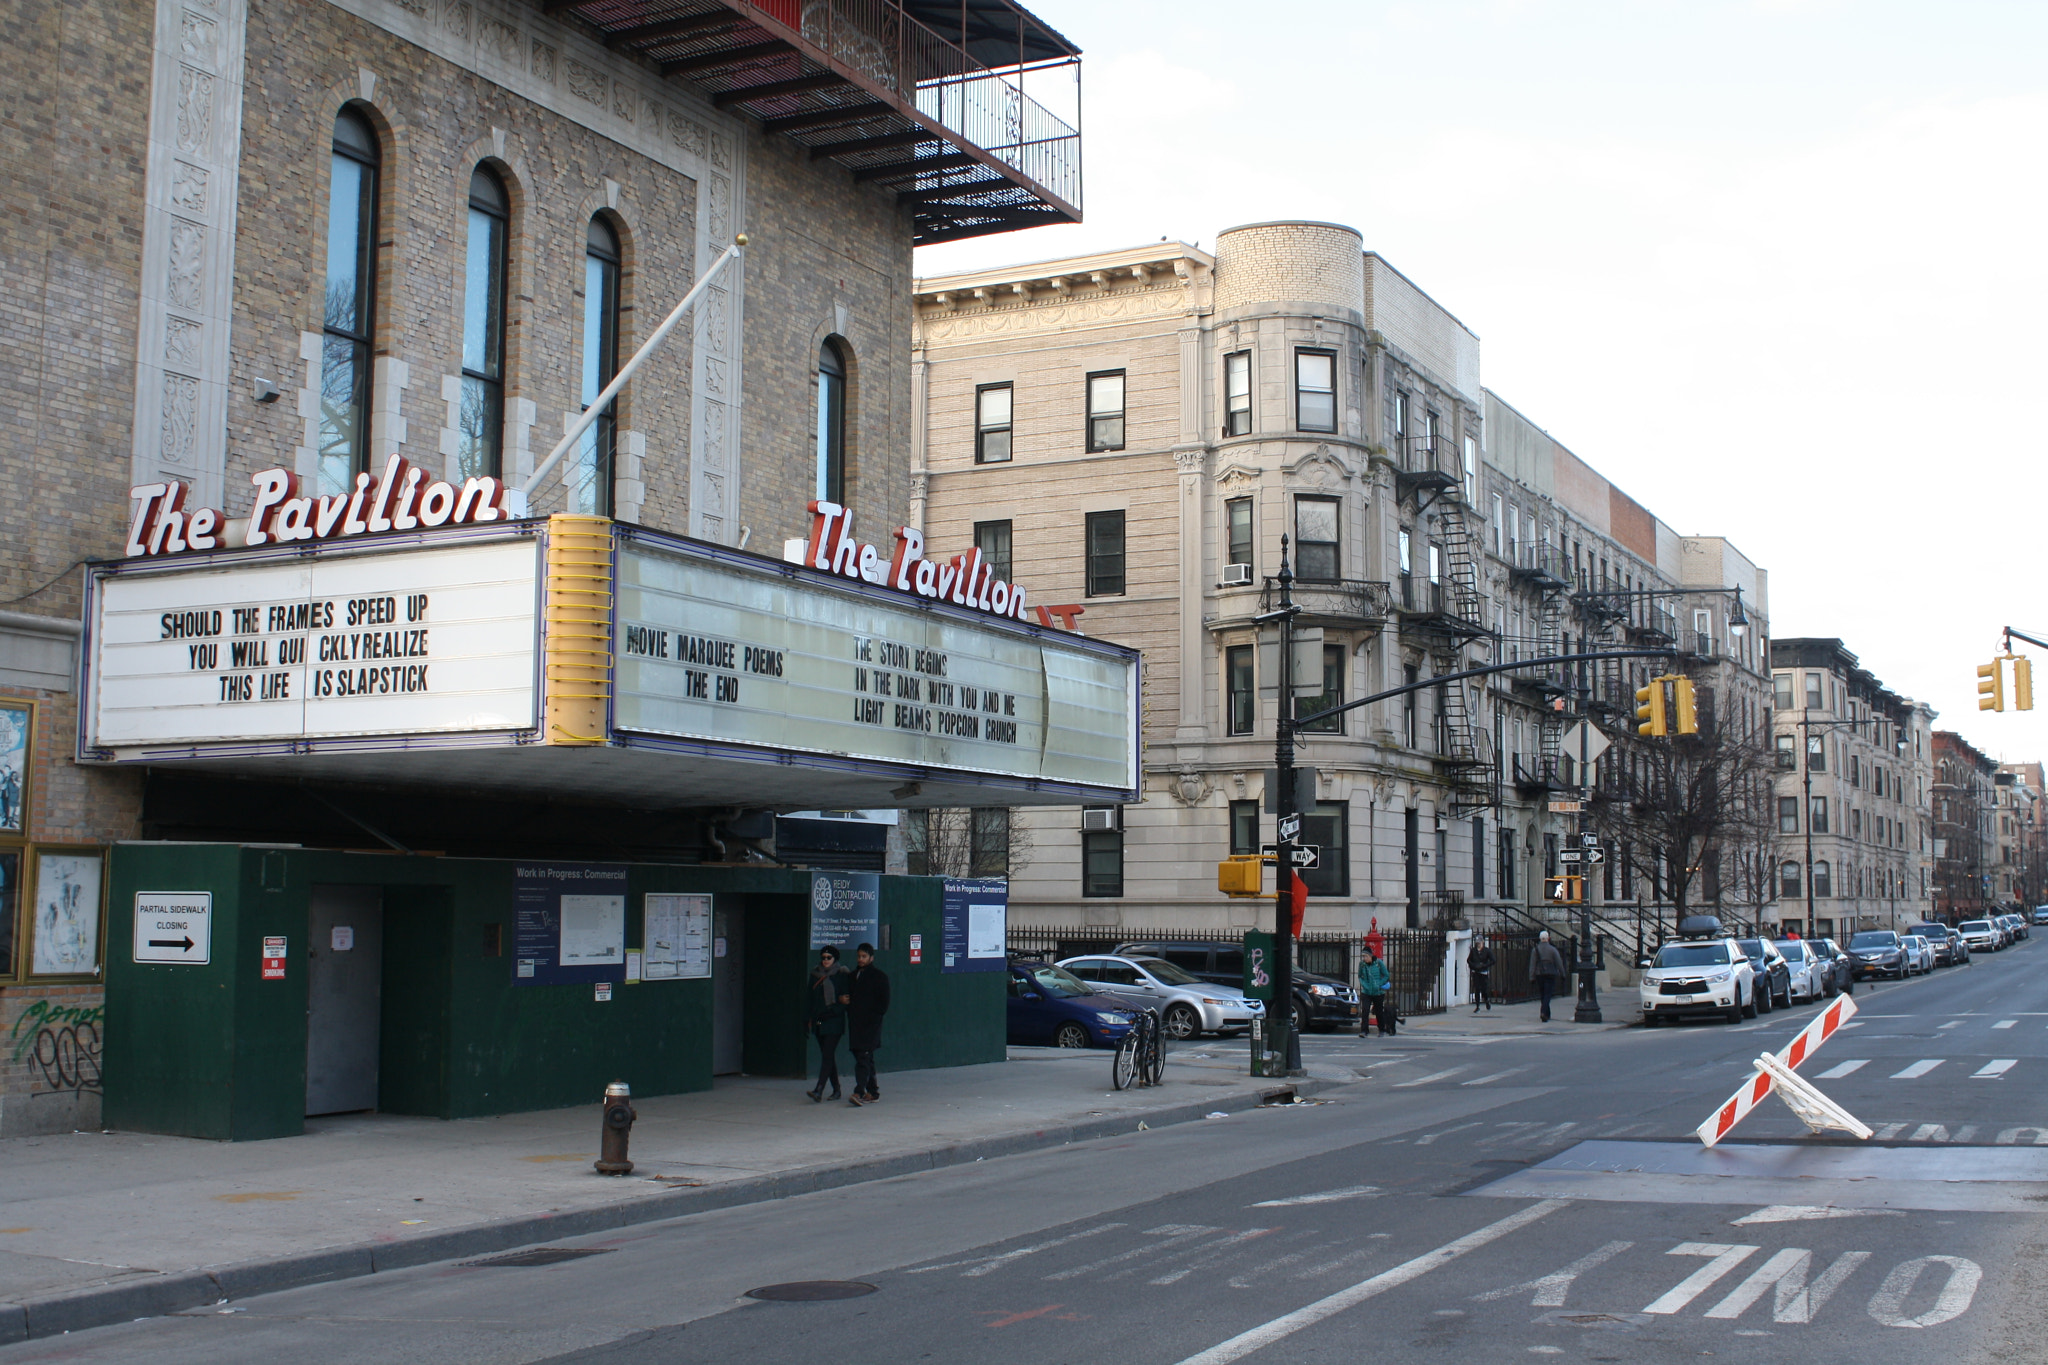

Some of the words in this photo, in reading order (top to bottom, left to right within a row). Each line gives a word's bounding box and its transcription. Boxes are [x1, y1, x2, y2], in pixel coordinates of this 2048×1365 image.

[126, 480, 224, 556] The
[245, 453, 506, 545] Pavilion
[807, 500, 879, 582] The
[892, 525, 1028, 620] Pavilion
[161, 610, 222, 640] SHOULD
[233, 608, 259, 634] THE
[268, 602, 334, 632] FRAMES
[347, 597, 396, 626] SPEED
[408, 594, 429, 622] UP
[189, 644, 218, 669] YOU
[232, 640, 268, 667] WILL
[627, 625, 668, 658] MOVIE
[677, 635, 735, 670] MARQUEE
[744, 647, 783, 677] POEMS
[853, 635, 873, 663] THE
[880, 639, 910, 669] STORY
[915, 647, 947, 677] BEGINS
[220, 675, 253, 701] THIS
[261, 672, 289, 700] LIFE
[315, 671, 333, 697] IS
[337, 665, 428, 696] SLAPSTICK
[685, 669, 708, 699] THE
[716, 675, 739, 703] END
[855, 667, 867, 692] IN
[873, 670, 891, 696] THE
[897, 674, 921, 701] DARK
[928, 680, 953, 707] WITH
[960, 685, 977, 709] YOU
[983, 689, 999, 714] AND
[1004, 693, 1016, 717] ME
[854, 697, 884, 725] LIGHT
[895, 703, 931, 732] BEAMS
[938, 710, 978, 738] POPCORN
[985, 717, 1016, 744] CRUNCH
[1295, 852, 1311, 861] WAY
[516, 868, 537, 878] Work
[538, 868, 546, 878] in
[547, 868, 583, 880] Progress:
[584, 869, 626, 879] Commercial
[833, 880, 851, 889] REIDY
[944, 884, 956, 892] Work
[957, 884, 961, 892] in
[982, 885, 1007, 894] Commercial
[815, 889, 830, 899] RCG
[833, 890, 876, 900] CONTRACTING
[140, 905, 169, 913] PARTIAL
[170, 905, 207, 914] SIDEWALK
[833, 901, 854, 910] GROUP
[156, 921, 188, 930] CLOSING
[271, 960, 279, 968] NO
[264, 968, 285, 977] SMOKING
